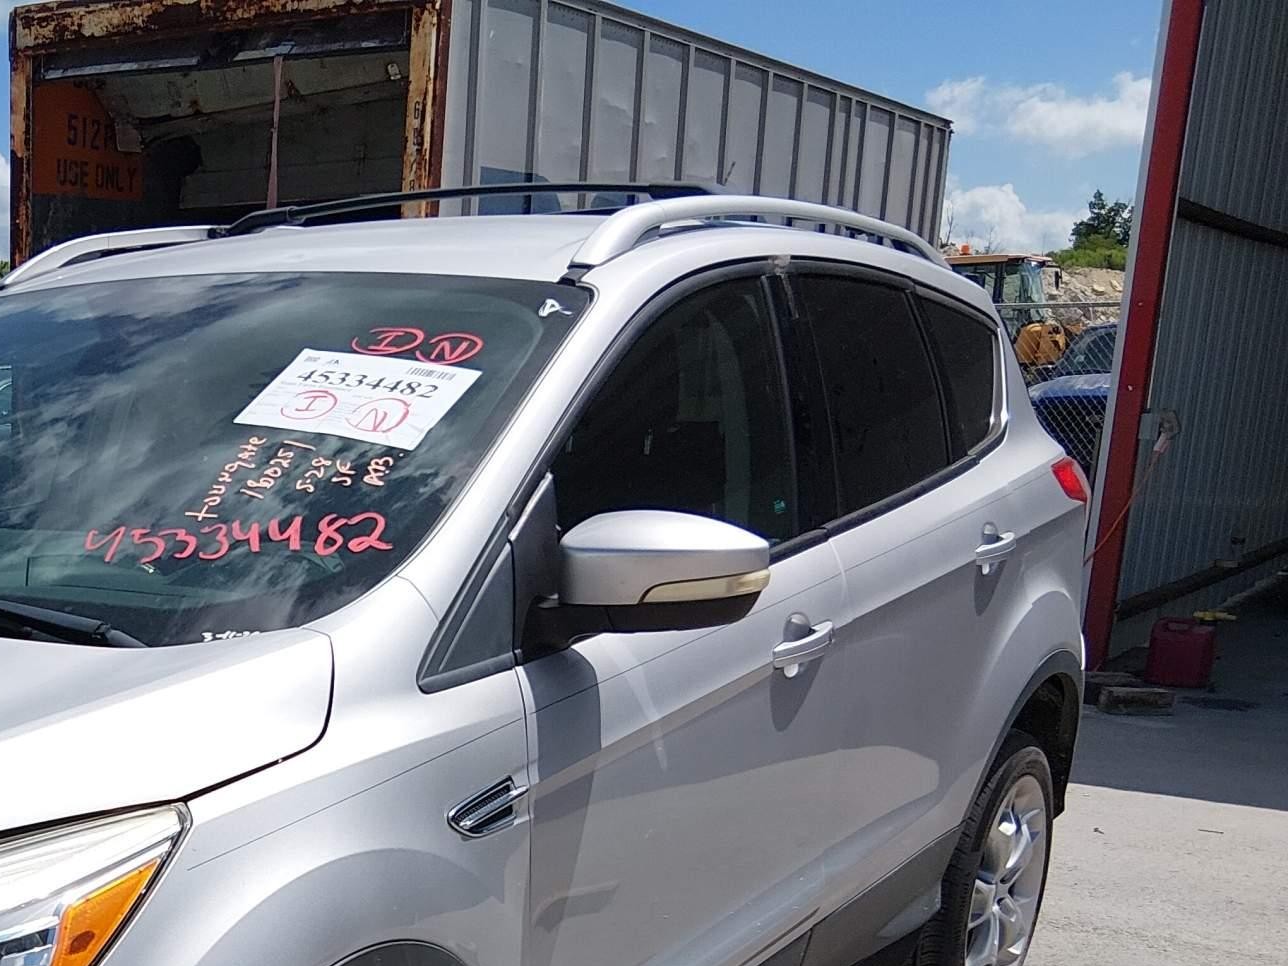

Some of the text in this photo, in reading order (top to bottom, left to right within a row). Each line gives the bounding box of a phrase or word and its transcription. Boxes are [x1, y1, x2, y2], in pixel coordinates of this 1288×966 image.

[56, 159, 137, 193] USE ONLY
[296, 368, 440, 399] 45334482
[84, 512, 393, 565] 45334482
